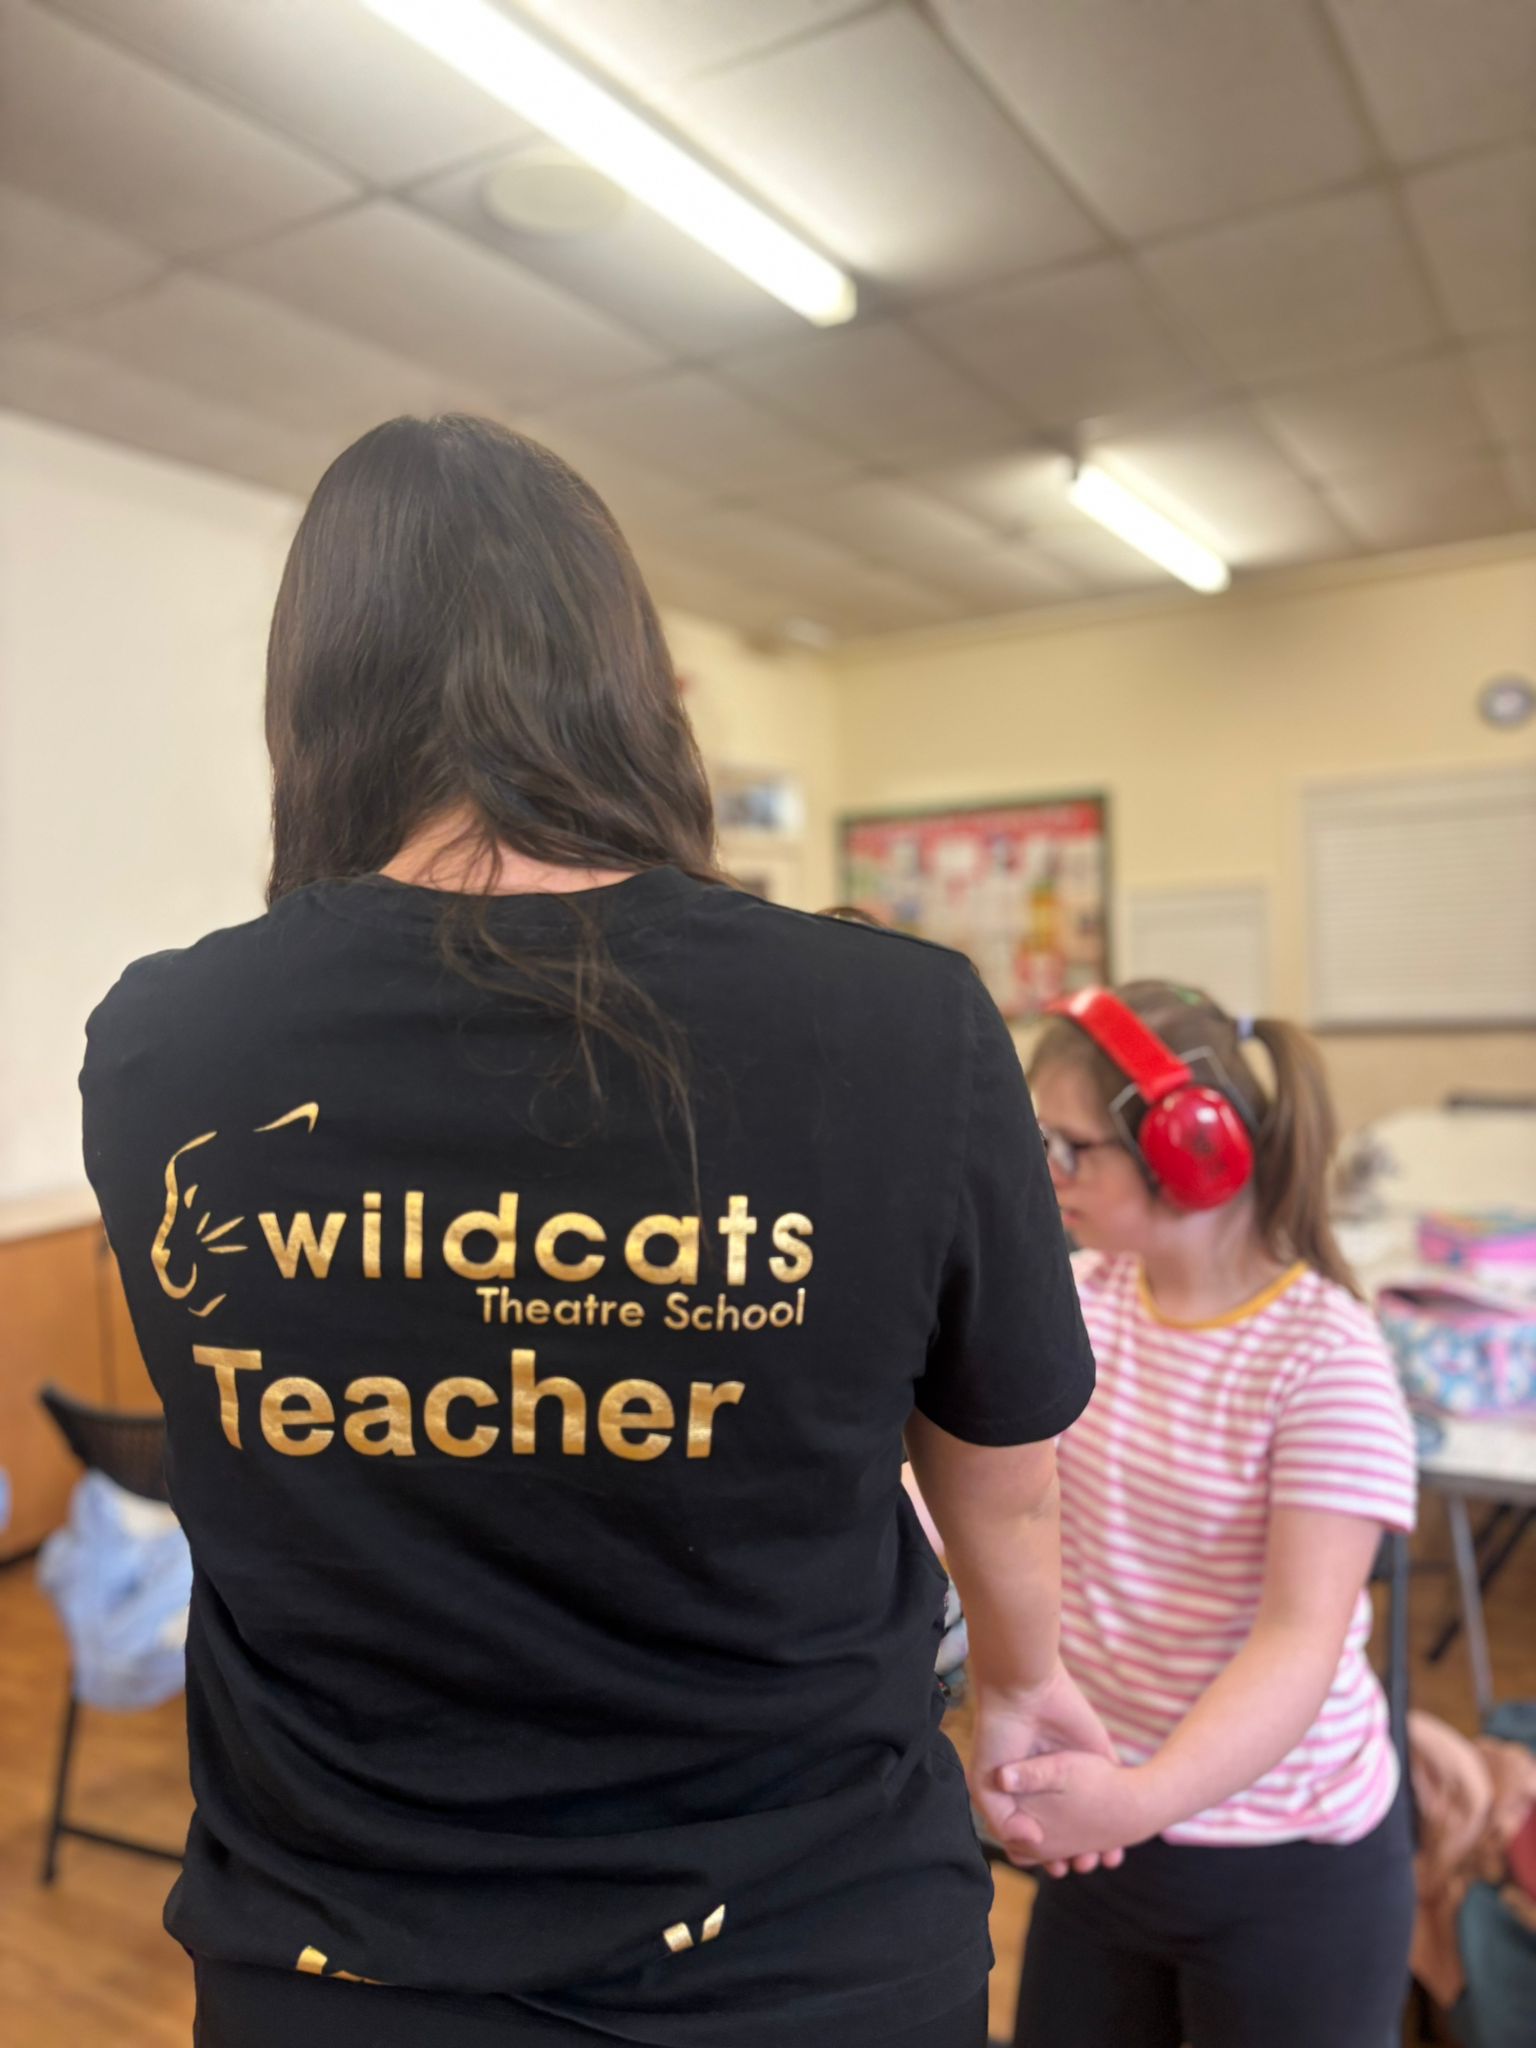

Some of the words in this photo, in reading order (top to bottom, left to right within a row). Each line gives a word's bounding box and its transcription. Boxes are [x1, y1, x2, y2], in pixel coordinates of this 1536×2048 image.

[257, 1190, 814, 1286] wildcats
[475, 1286, 645, 1327] Theatre
[664, 1287, 806, 1331] School
[192, 1344, 745, 1461] Teacher
